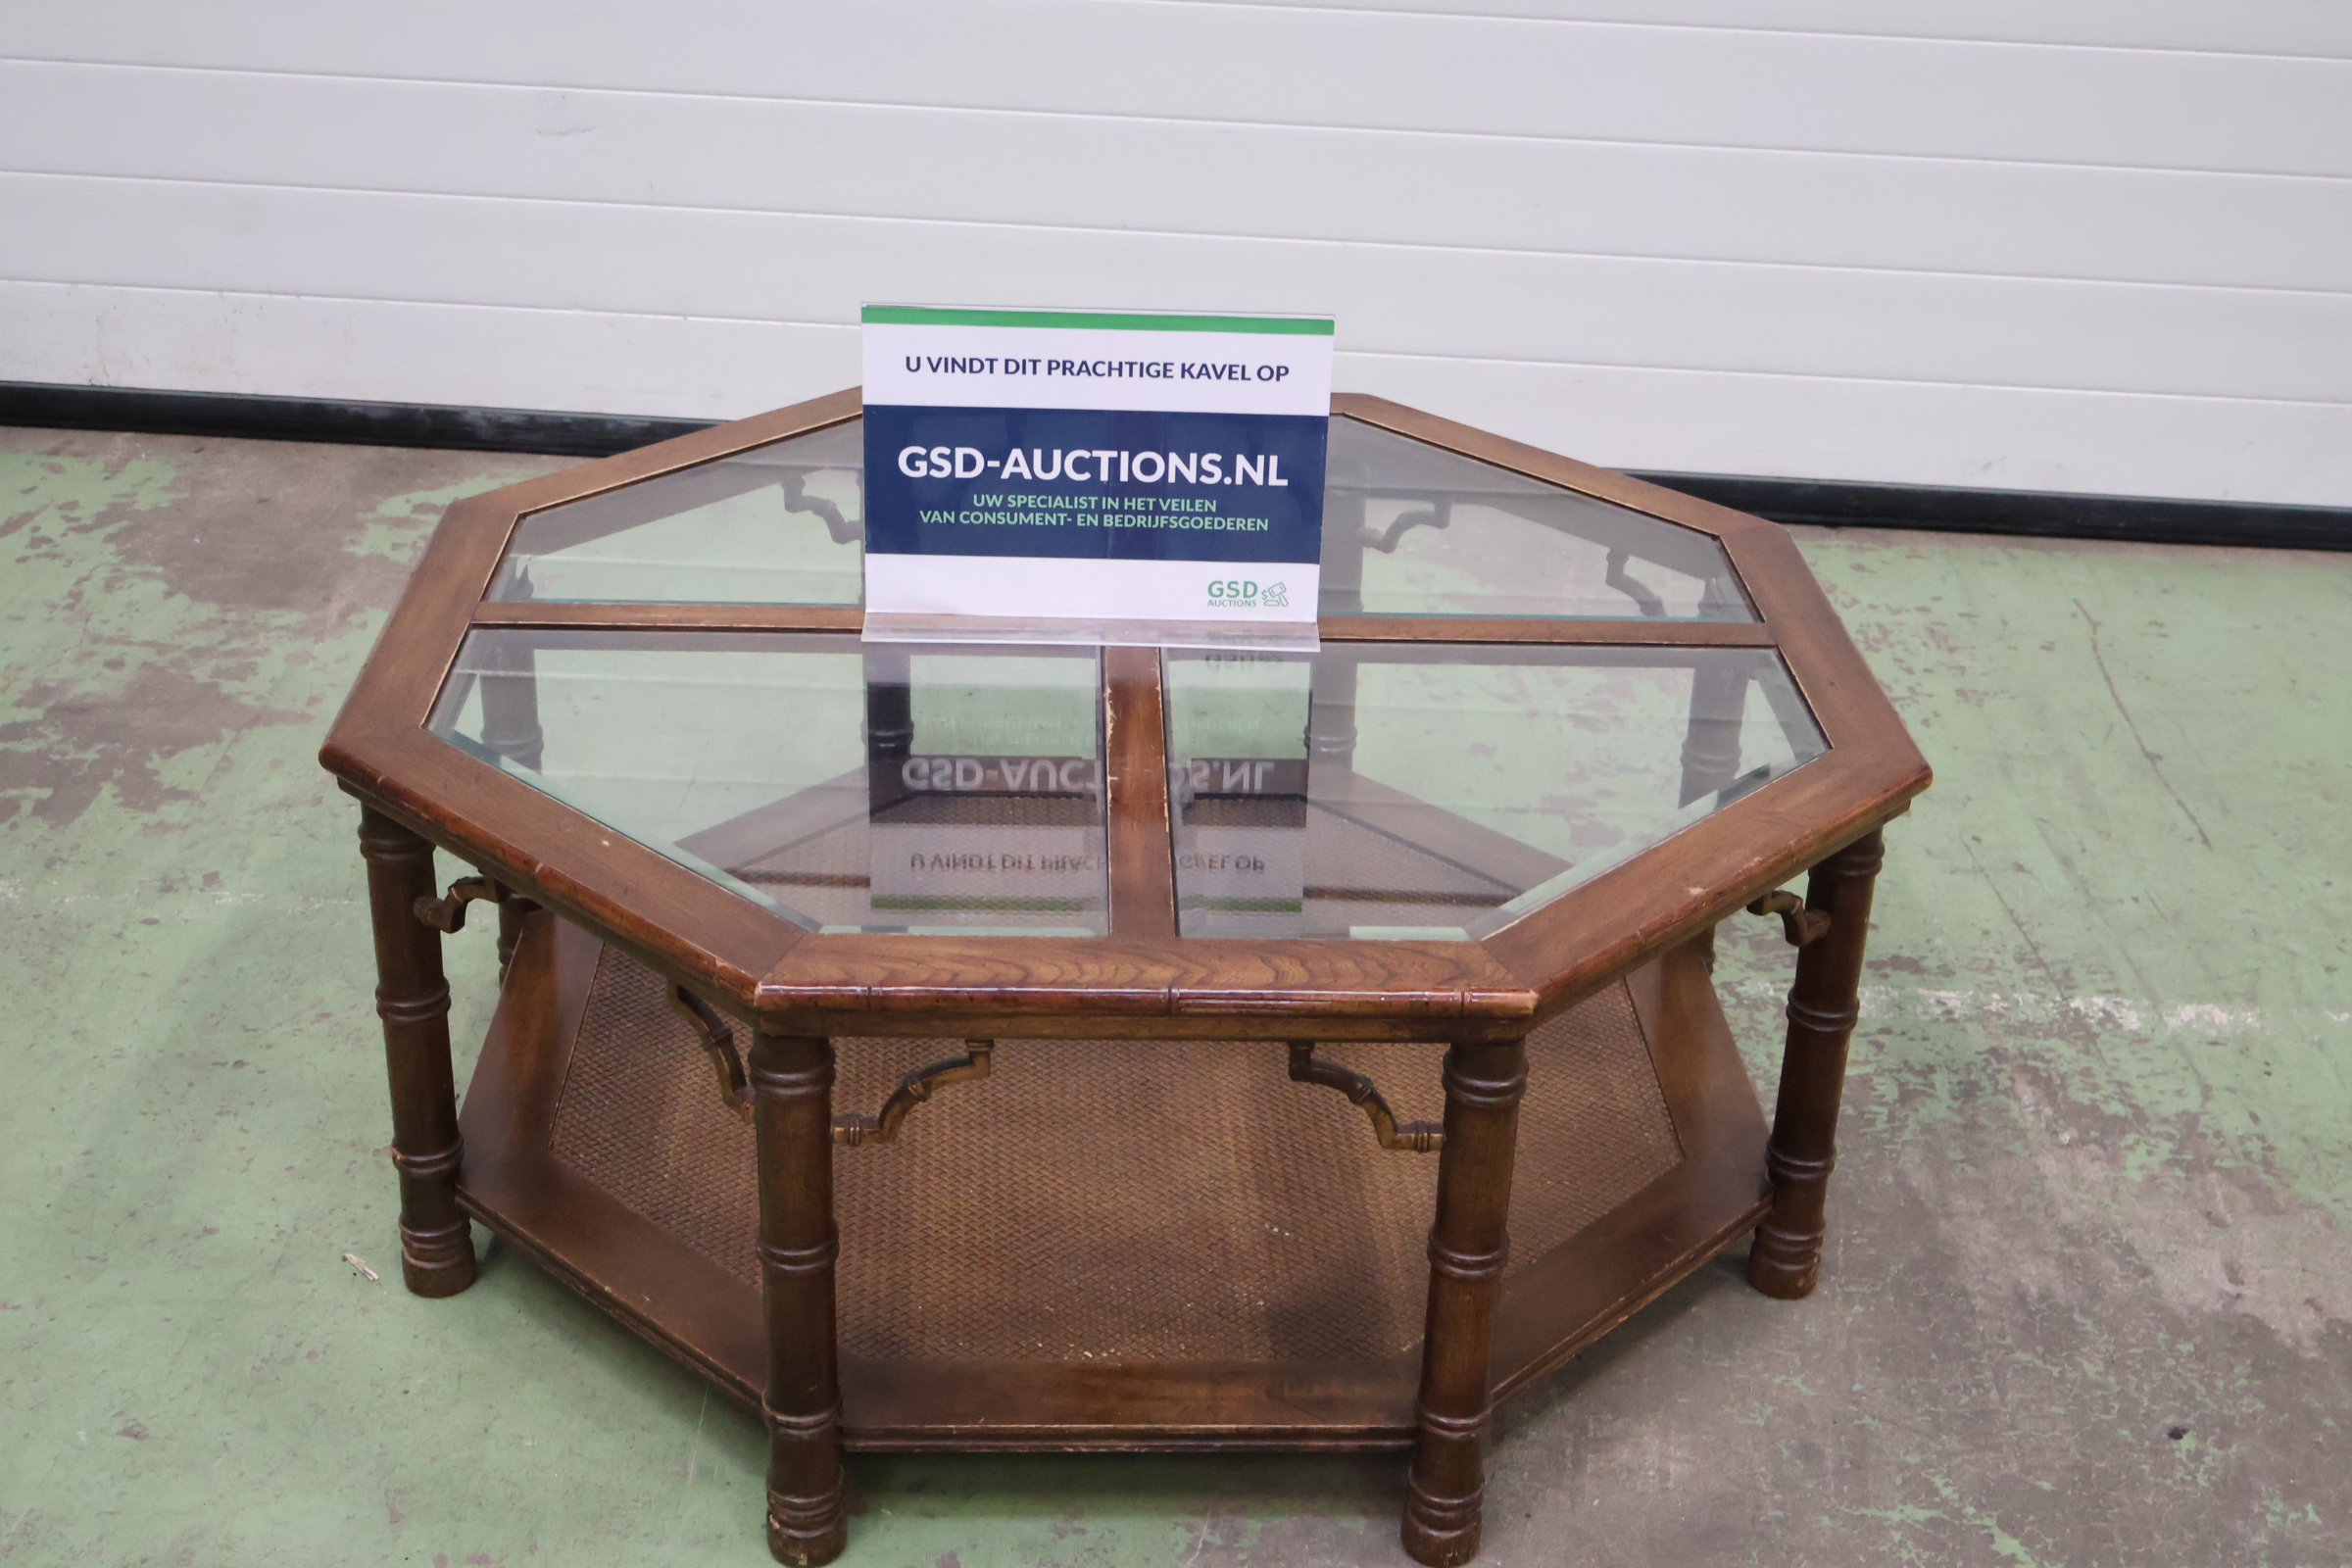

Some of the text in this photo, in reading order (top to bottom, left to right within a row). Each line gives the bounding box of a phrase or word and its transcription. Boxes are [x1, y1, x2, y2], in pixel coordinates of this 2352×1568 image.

[906, 356, 1290, 382] U VINDT DIT PRACHTIGE KAVEL OP
[898, 445, 1289, 487] GSD-AUCTIONS.NL
[973, 494, 1217, 513] UW SPECIALIST IN HET VEILEN
[919, 510, 1269, 531] VAN CONSUMENT- EN BEDRIJFSGOEDEREN
[1207, 580, 1258, 599] GSD
[1206, 599, 1257, 608] AUCTIONS
